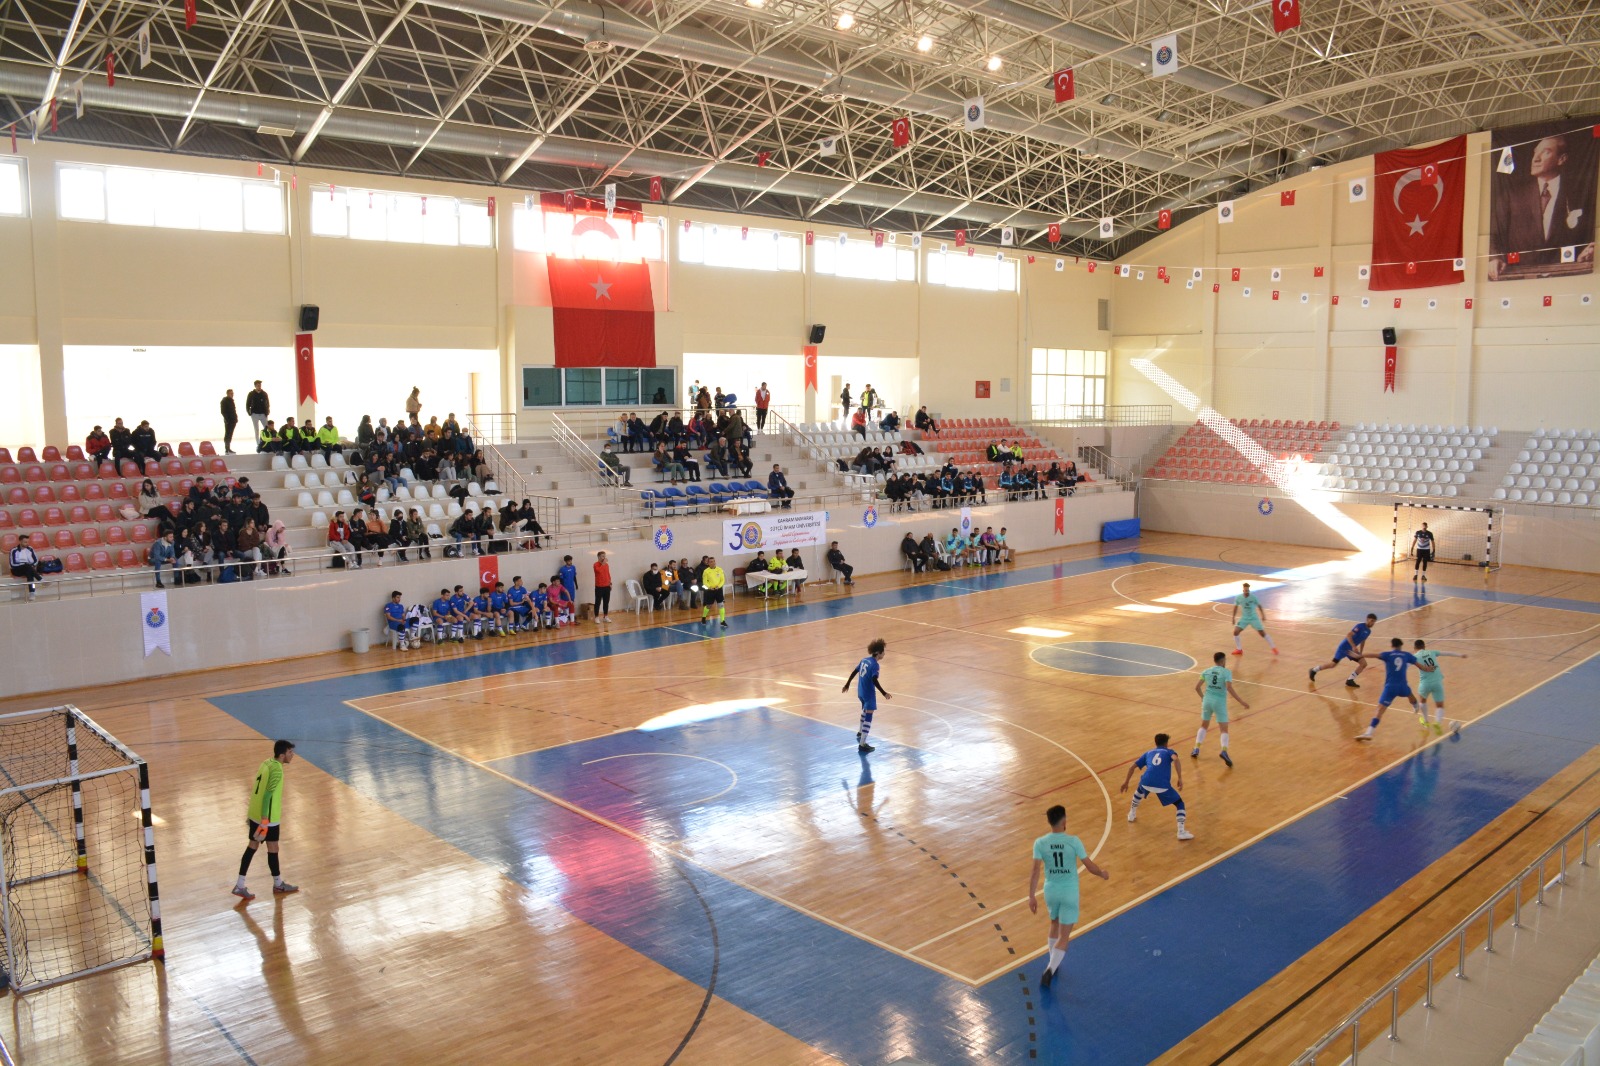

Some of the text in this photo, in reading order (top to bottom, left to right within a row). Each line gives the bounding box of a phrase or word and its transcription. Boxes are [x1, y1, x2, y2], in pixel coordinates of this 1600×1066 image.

[1393, 656, 1403, 671] 9
[1212, 675, 1218, 685] 8
[1151, 752, 1162, 766] 6
[254, 774, 262, 795] 1
[1052, 851, 1064, 868] 11
